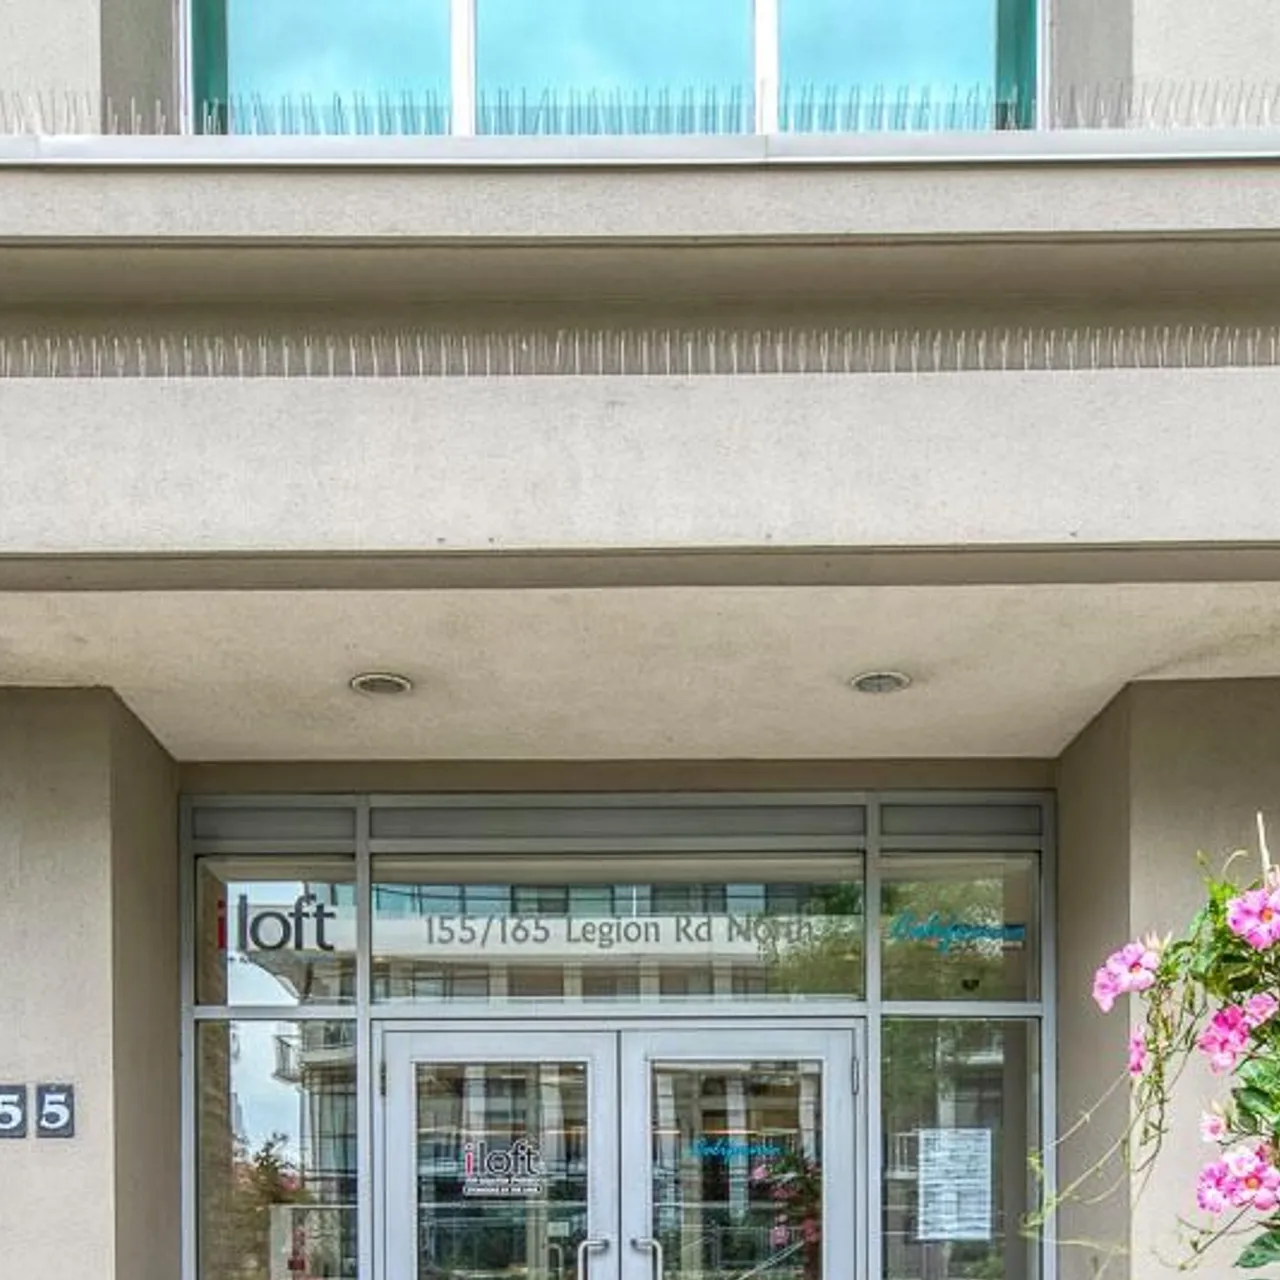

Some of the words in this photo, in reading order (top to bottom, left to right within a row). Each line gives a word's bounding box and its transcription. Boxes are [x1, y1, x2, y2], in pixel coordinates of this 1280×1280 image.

[425, 914, 550, 948] 155/165
[566, 914, 660, 949] Legion
[676, 914, 713, 944] Rd
[728, 914, 812, 943] North
